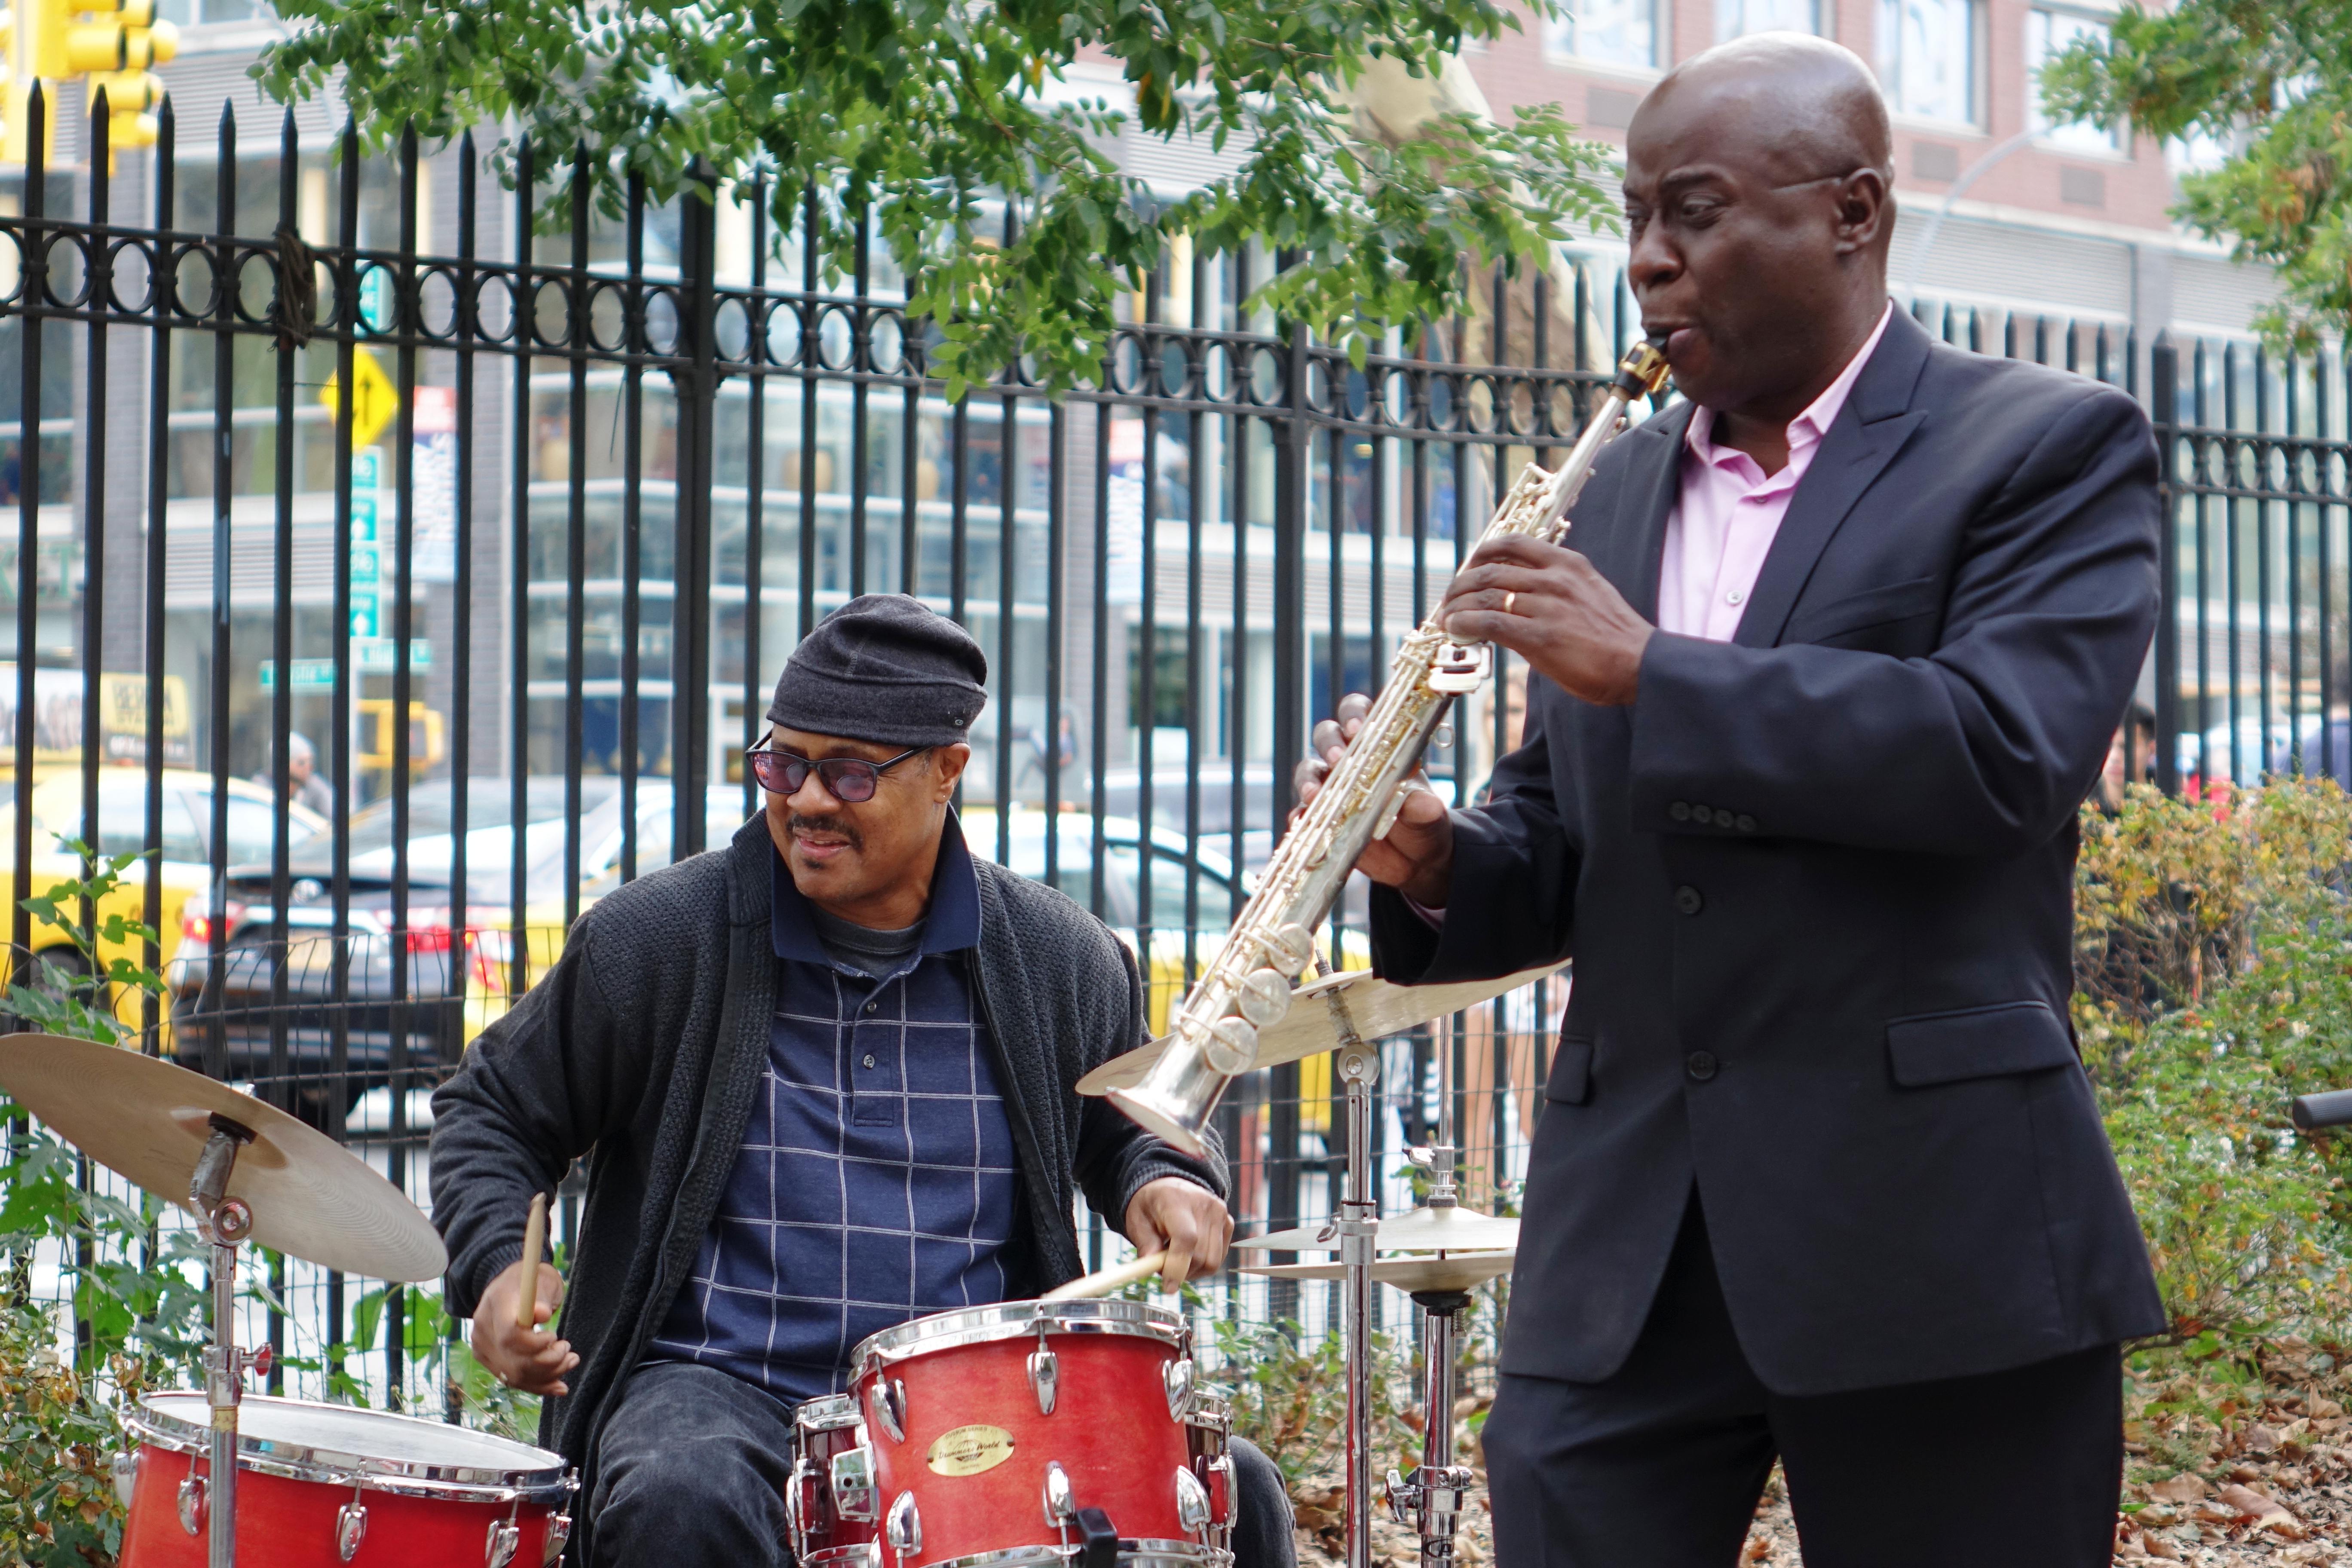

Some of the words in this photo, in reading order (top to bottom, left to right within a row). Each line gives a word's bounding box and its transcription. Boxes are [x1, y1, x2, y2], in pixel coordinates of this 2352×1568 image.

[414, 443, 434, 540] LUXURY
[432, 433, 454, 540] RENTALS
[939, 1446, 974, 1459] Drummers
[977, 1440, 1000, 1451] World
